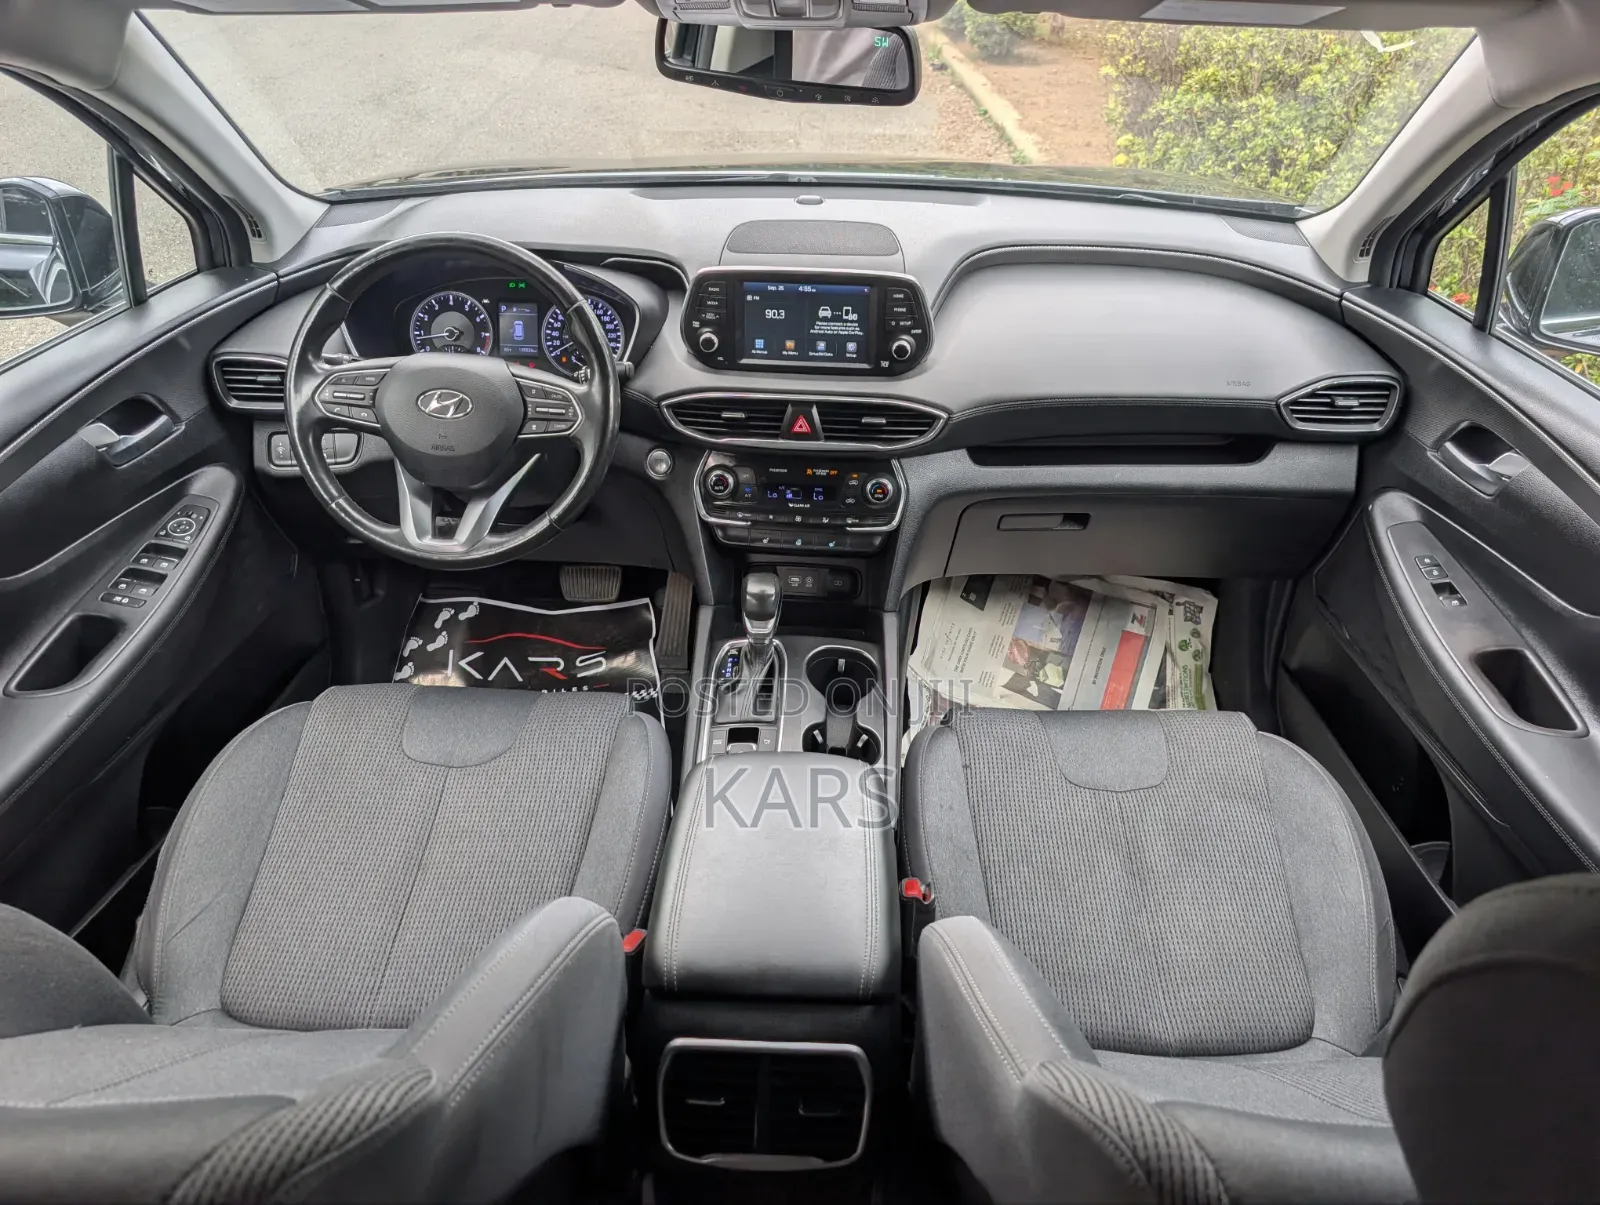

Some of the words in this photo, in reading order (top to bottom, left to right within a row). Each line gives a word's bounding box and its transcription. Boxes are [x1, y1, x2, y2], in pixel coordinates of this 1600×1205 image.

[874, 36, 889, 48] SW
[765, 309, 785, 319] 90.3
[448, 649, 606, 682] KARS
